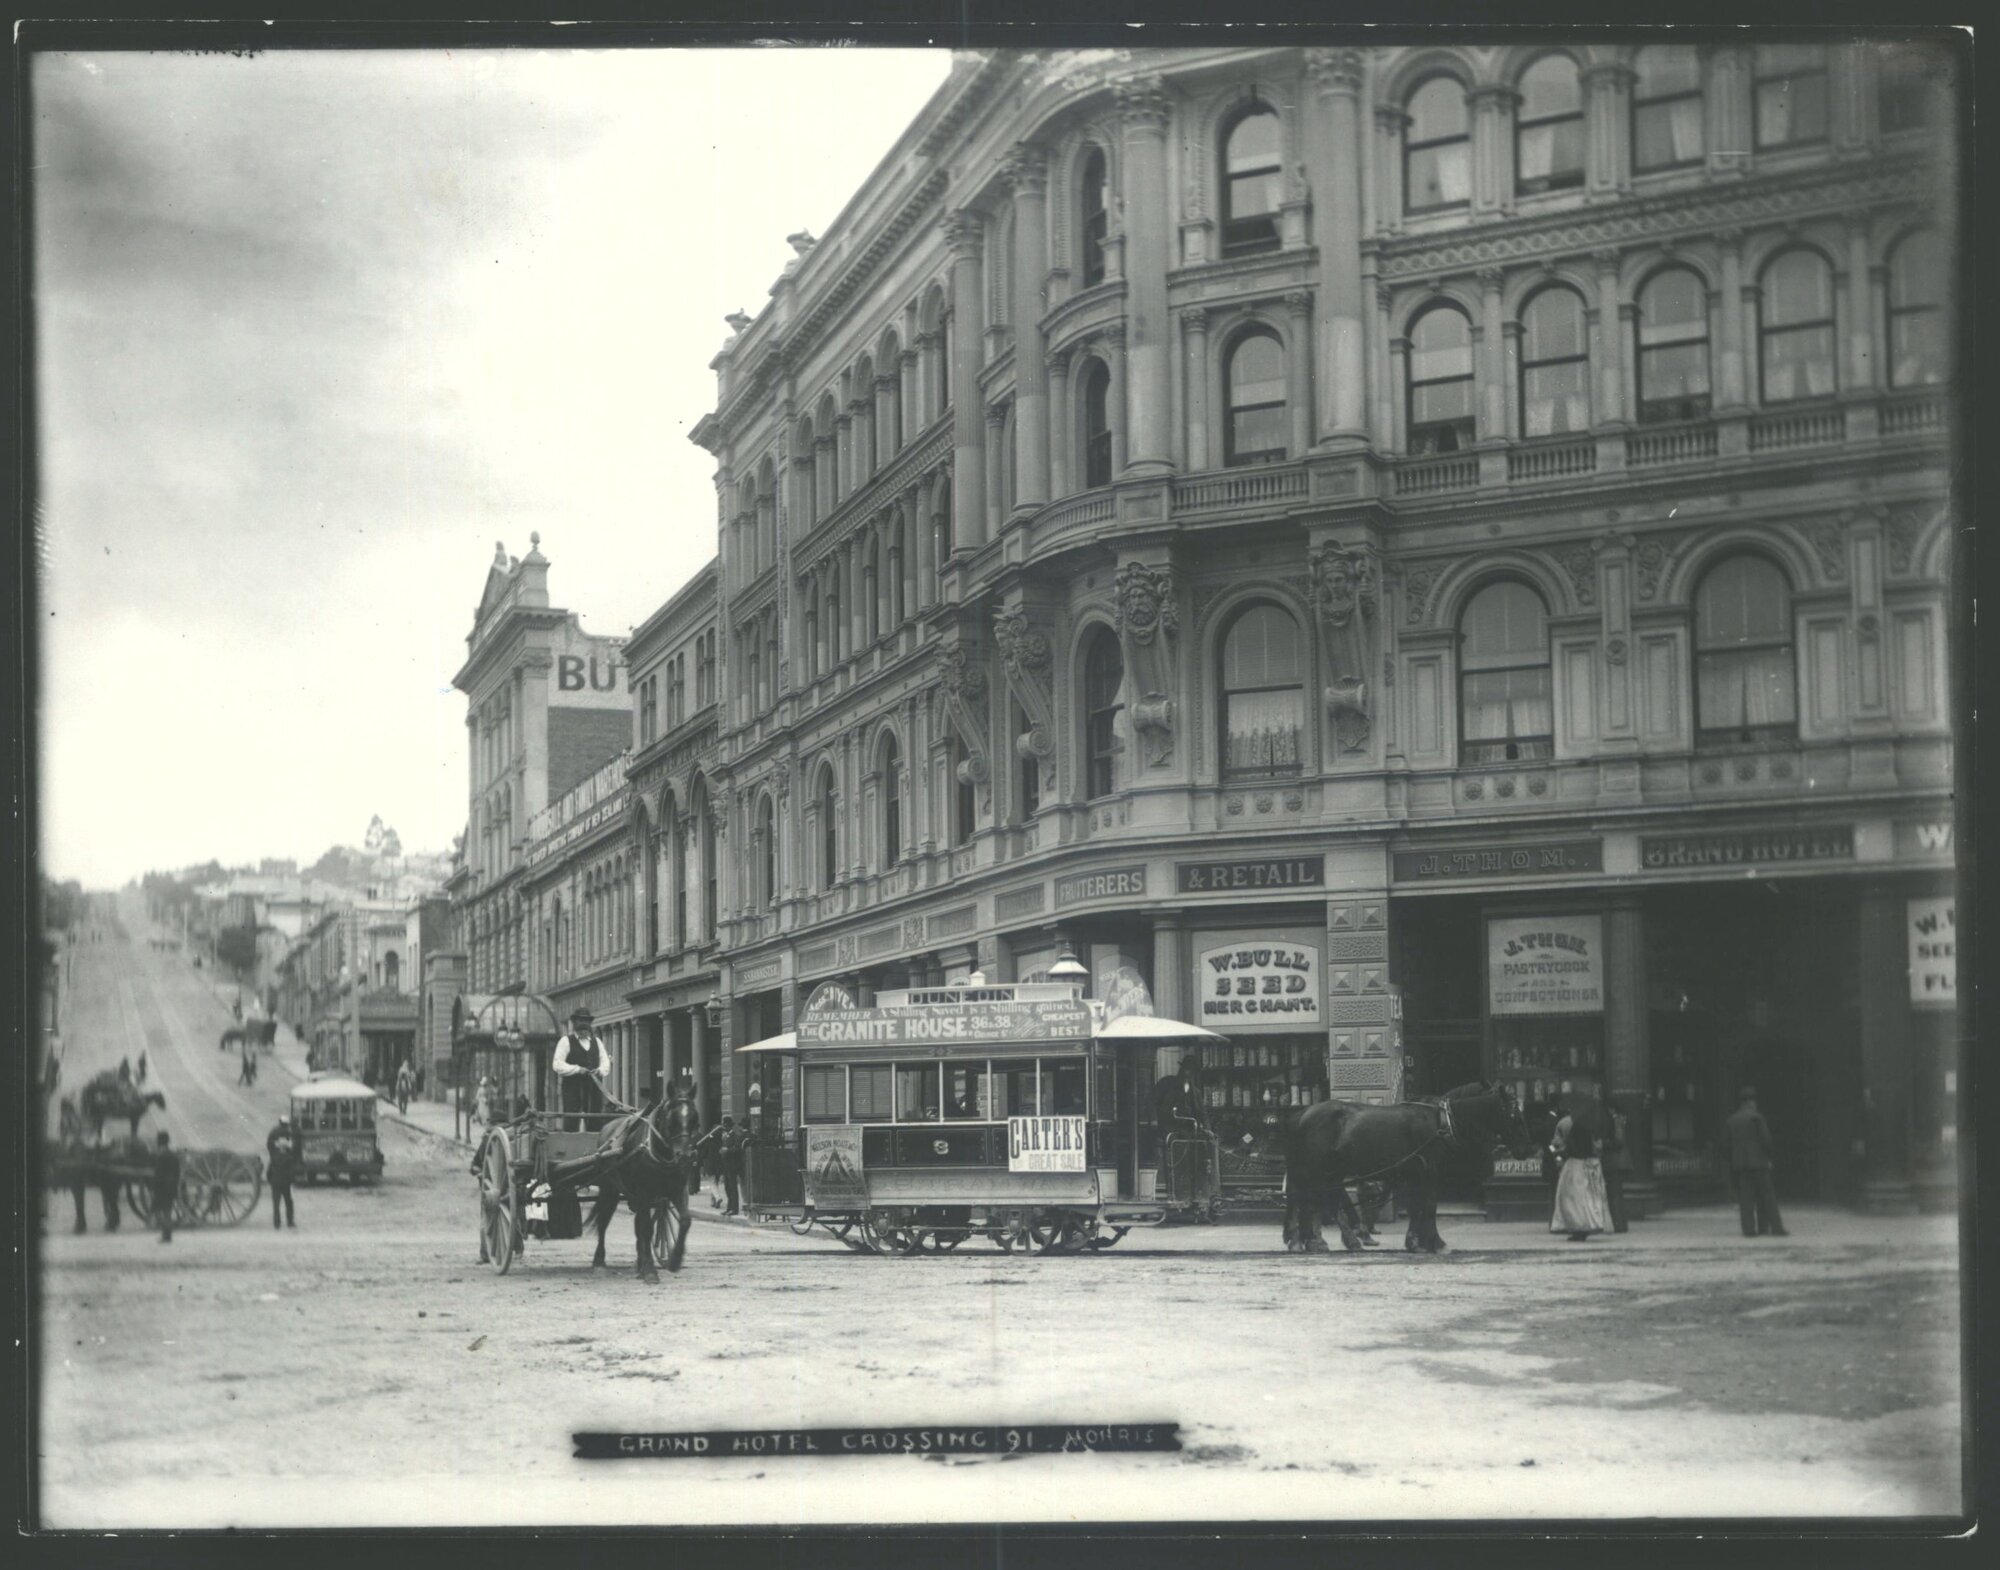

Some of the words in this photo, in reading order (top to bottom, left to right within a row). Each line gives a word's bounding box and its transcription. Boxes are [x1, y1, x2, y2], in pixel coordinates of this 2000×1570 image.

[1188, 869, 1205, 888] &
[1212, 862, 1316, 887] RETAIL
[1060, 872, 1143, 901] FRUITERERS
[1504, 960, 1590, 976] PASTRYCOOK
[1216, 975, 1306, 995] SEED
[910, 989, 1013, 1005] DUNEDIN
[1494, 988, 1599, 1004] CONFECTIONER
[1204, 998, 1316, 1015] MERCHANT.
[806, 1010, 871, 1022] REMEMBER
[1042, 1012, 1087, 1022] CHEAPEST
[819, 1020, 898, 1041] GRANITE
[1010, 1118, 1084, 1158] CARTER'S
[1029, 1153, 1058, 1170] GREAT
[1060, 1153, 1084, 1170] SALE
